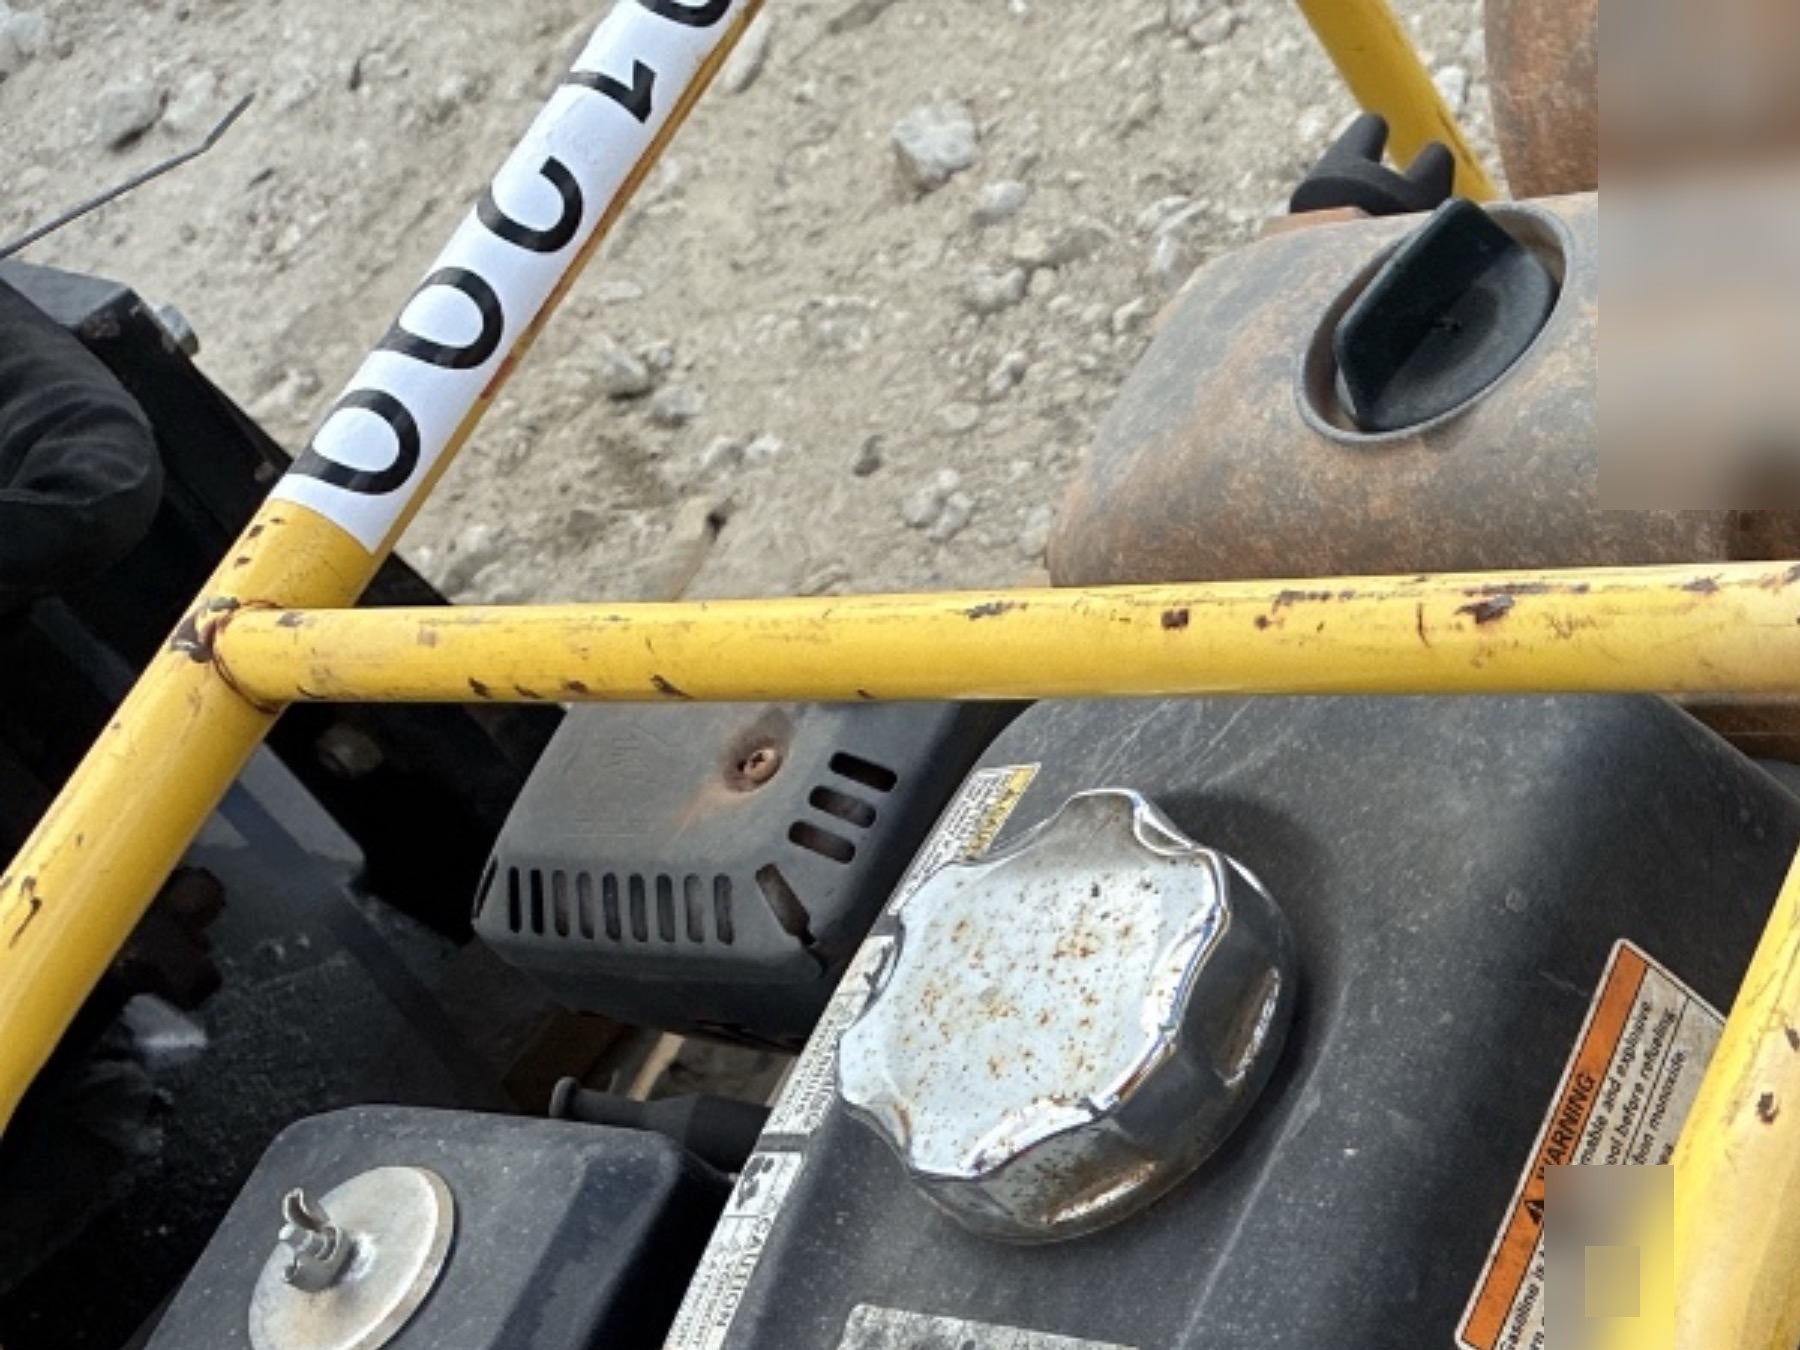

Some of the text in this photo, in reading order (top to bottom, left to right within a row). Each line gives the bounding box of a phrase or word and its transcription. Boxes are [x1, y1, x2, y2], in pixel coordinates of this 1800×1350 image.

[1602, 1076, 1622, 1113] and
[1615, 1001, 1651, 1078] explosive
[1614, 1082, 1645, 1138] before
[716, 1215, 772, 1328] CAUTION
